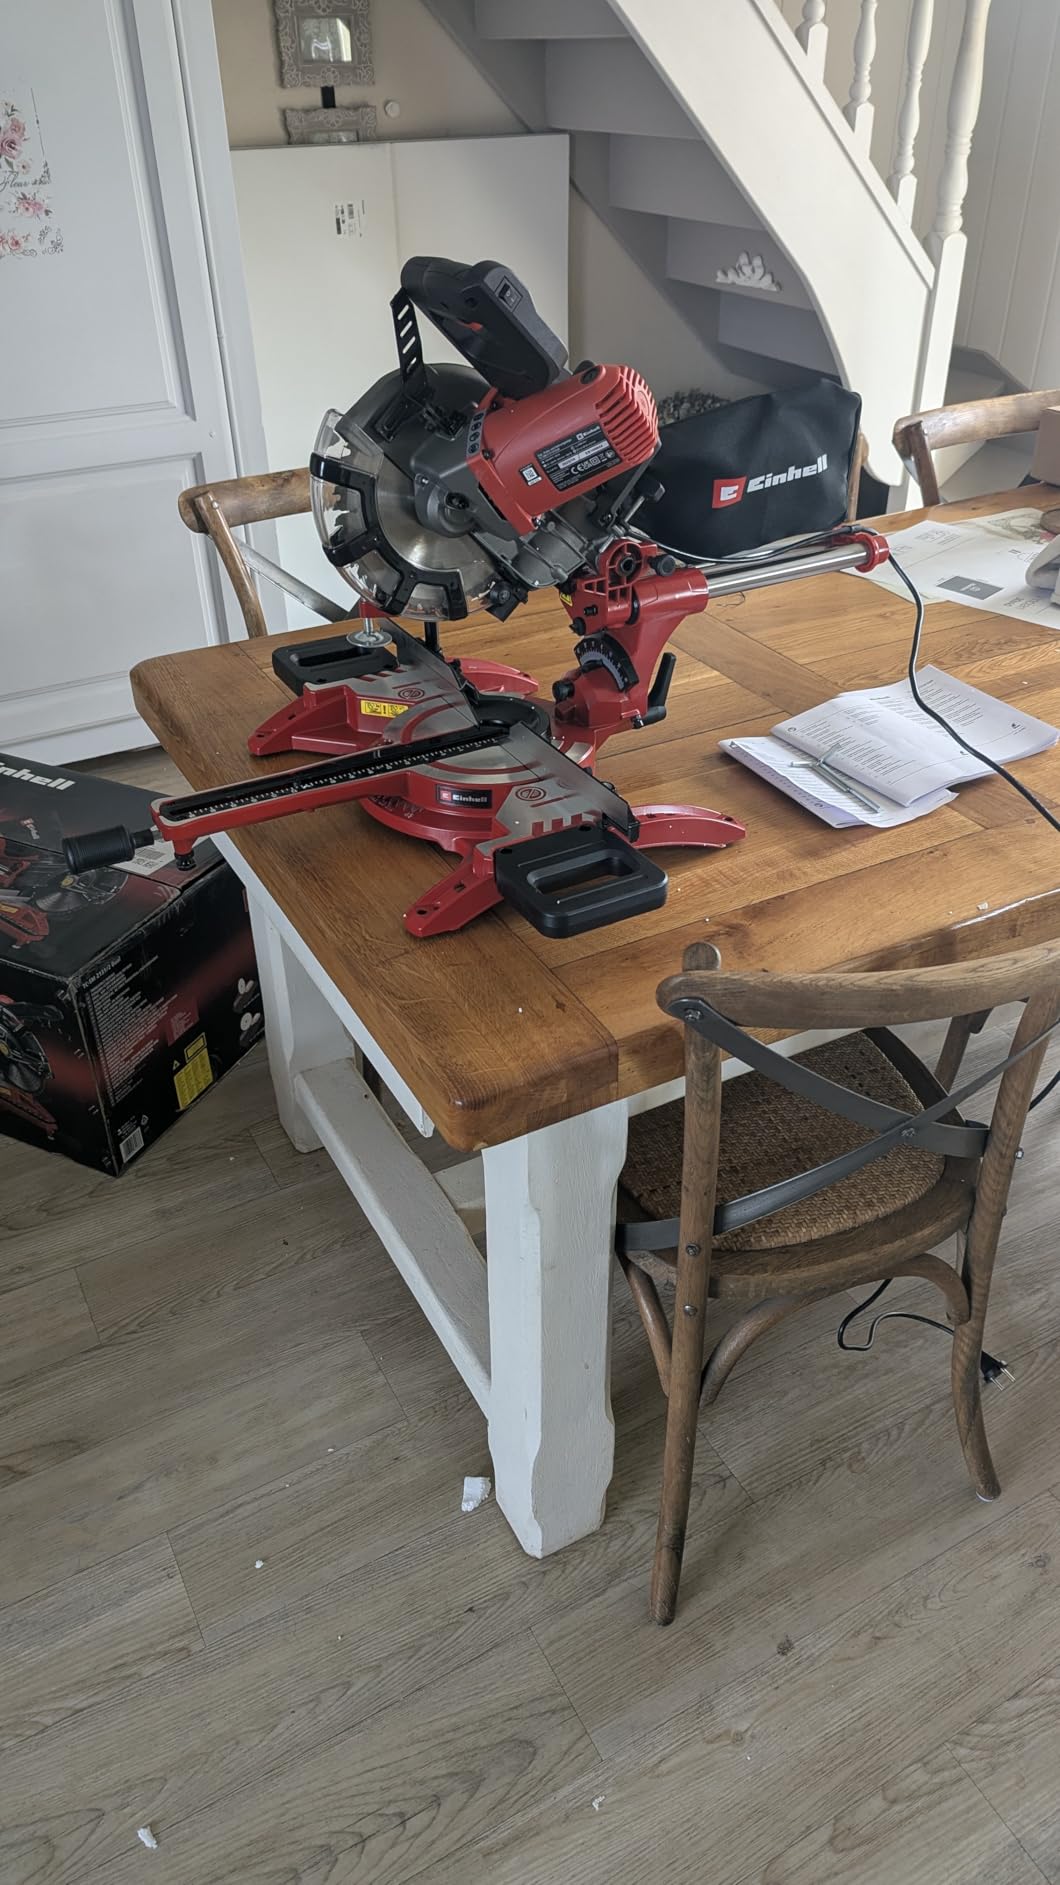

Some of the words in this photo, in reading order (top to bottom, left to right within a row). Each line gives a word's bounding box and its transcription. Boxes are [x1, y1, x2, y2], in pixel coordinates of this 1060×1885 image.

[746, 453, 828, 493] Einhell
[0, 761, 76, 791] nhell
[452, 794, 488, 803] Einhell
